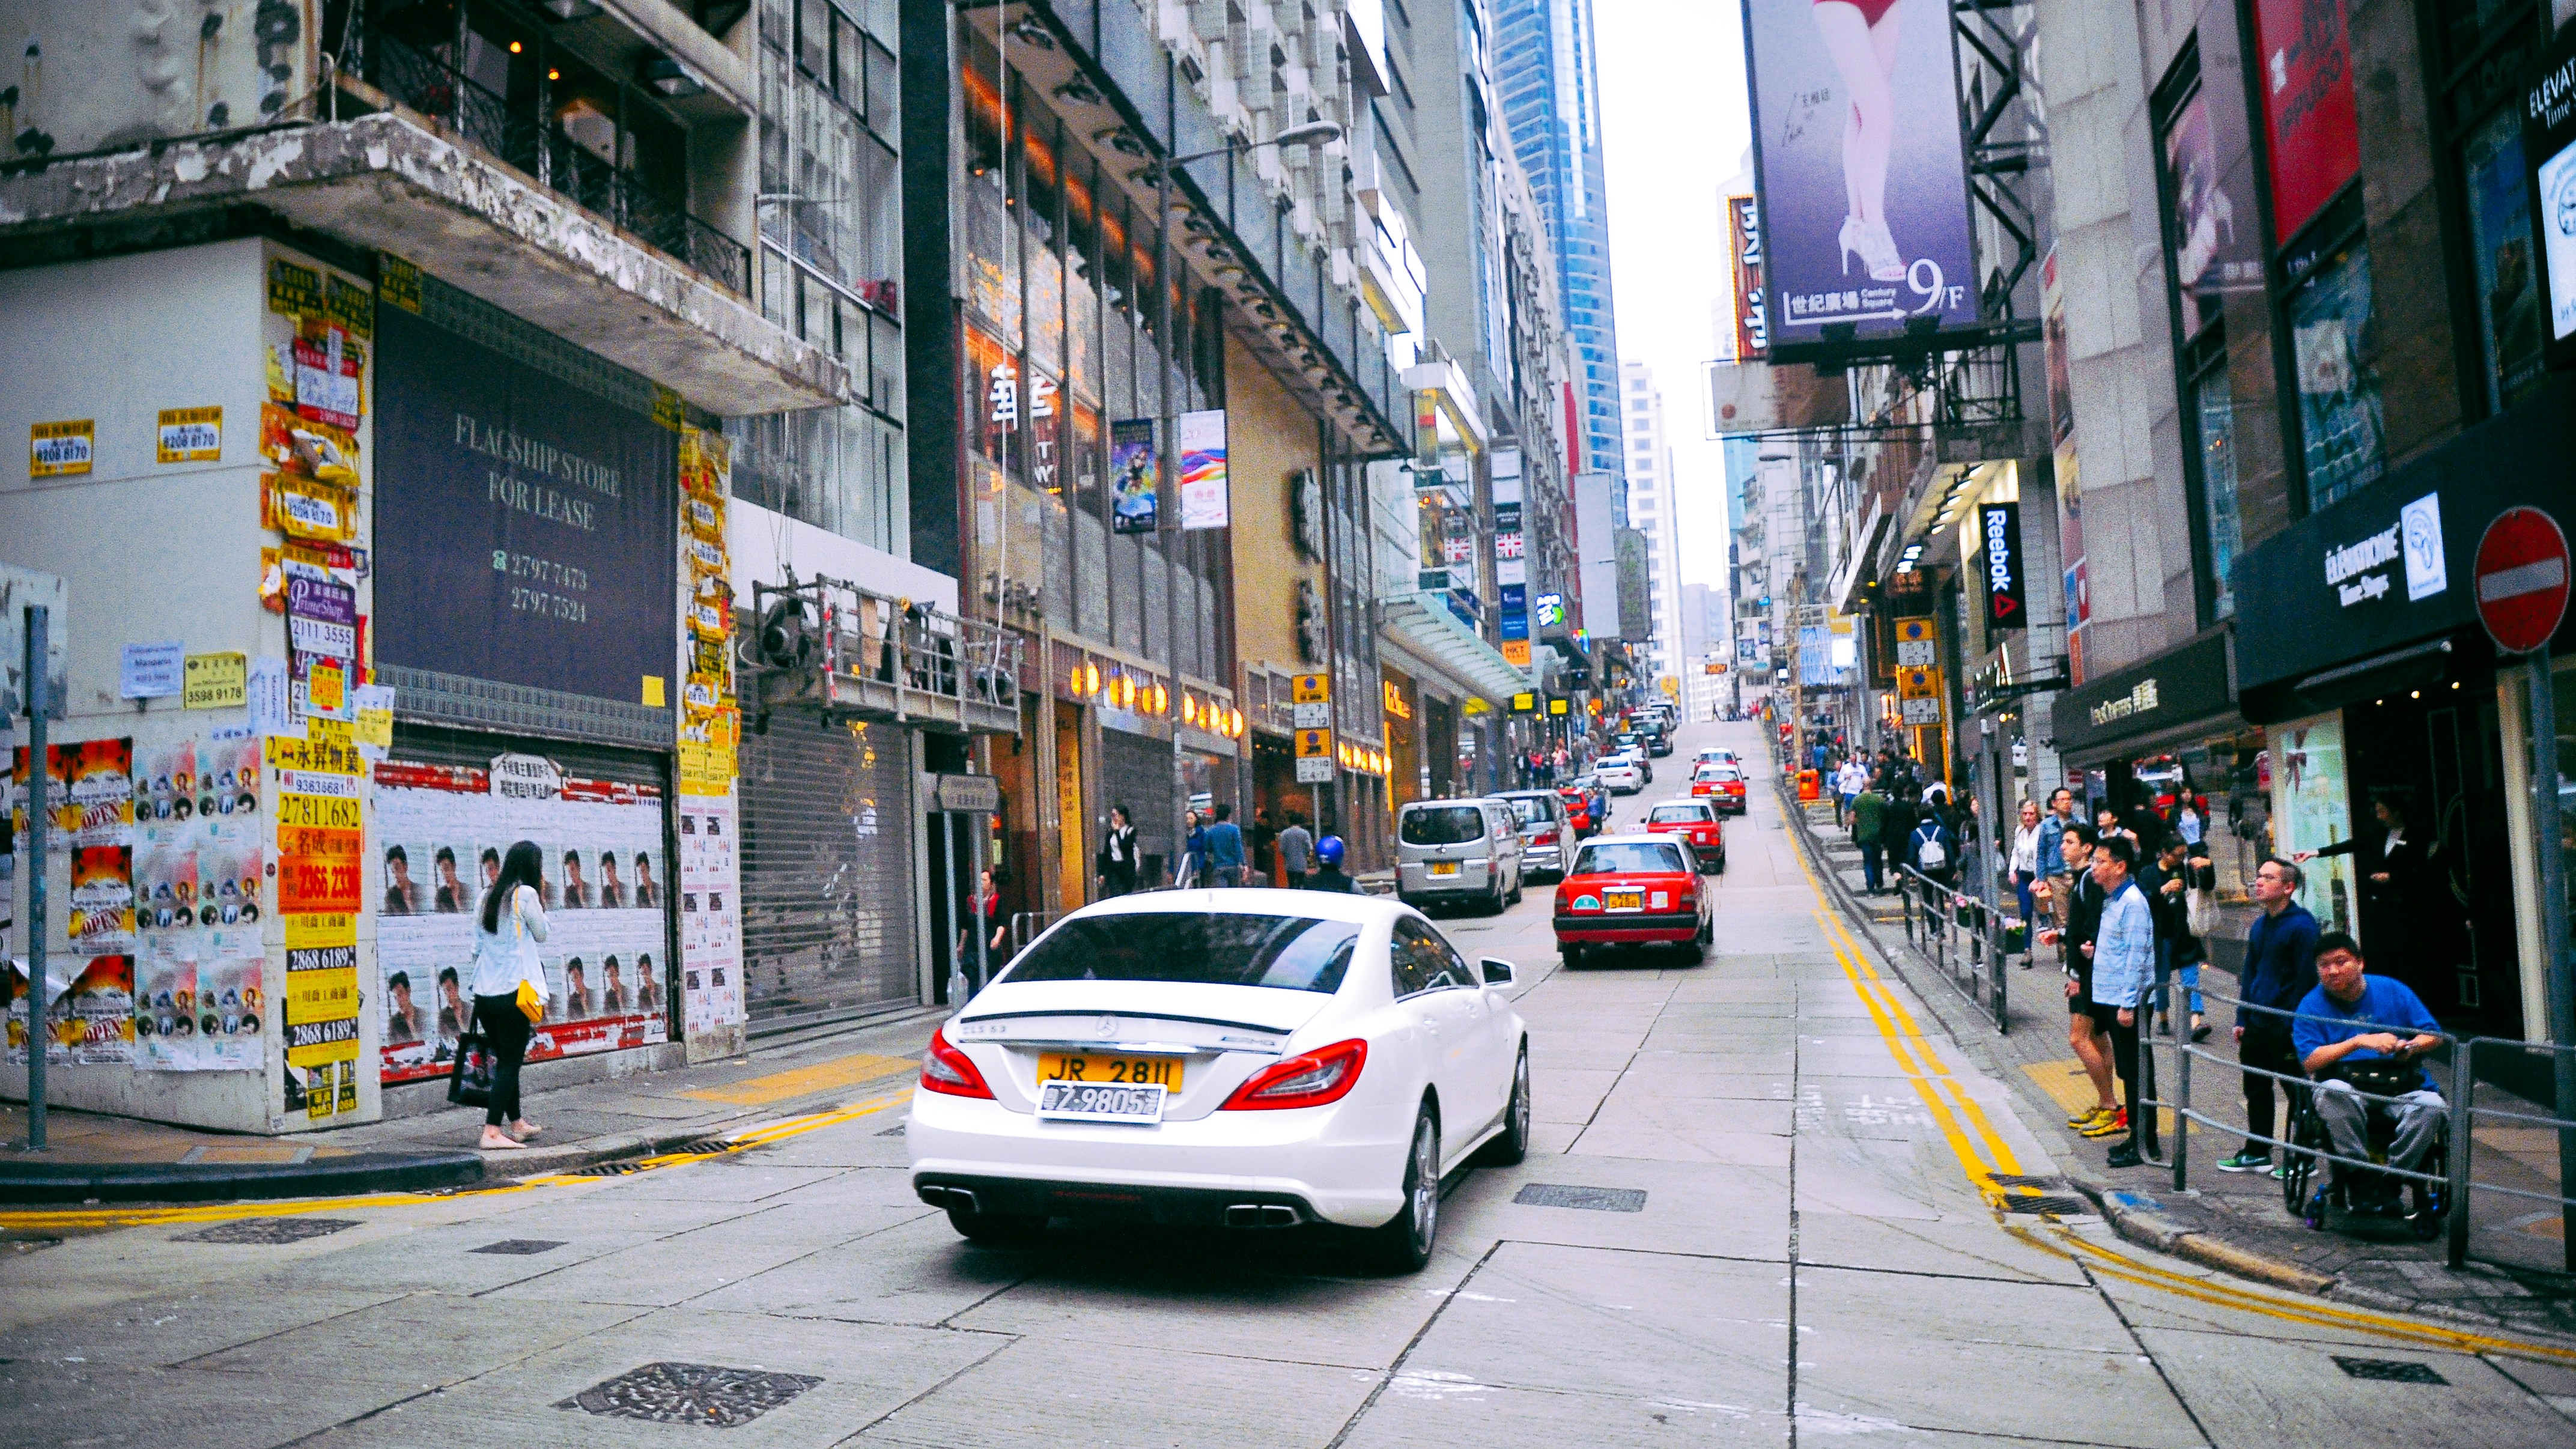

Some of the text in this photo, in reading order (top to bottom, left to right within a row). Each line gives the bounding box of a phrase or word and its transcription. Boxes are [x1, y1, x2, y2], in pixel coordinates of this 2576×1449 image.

[1907, 258, 1965, 315] 9/F
[1792, 291, 1859, 314] 世紀廣場
[456, 413, 621, 498] FLAGSHIP STORE
[488, 471, 594, 532] FOR LEASE
[1986, 509, 2011, 592] Reebok
[511, 554, 588, 591] 2797 7473
[511, 588, 548, 613] 2797
[291, 619, 351, 645] 2111 3555
[83, 799, 120, 829] OPEN
[282, 795, 358, 827] 27811682
[83, 909, 121, 937] OPEN
[291, 947, 348, 971] 2868 6189
[83, 1016, 121, 1045] OPEN
[293, 1019, 350, 1046] 2868 6189
[1048, 1057, 1170, 1085] JR 2811
